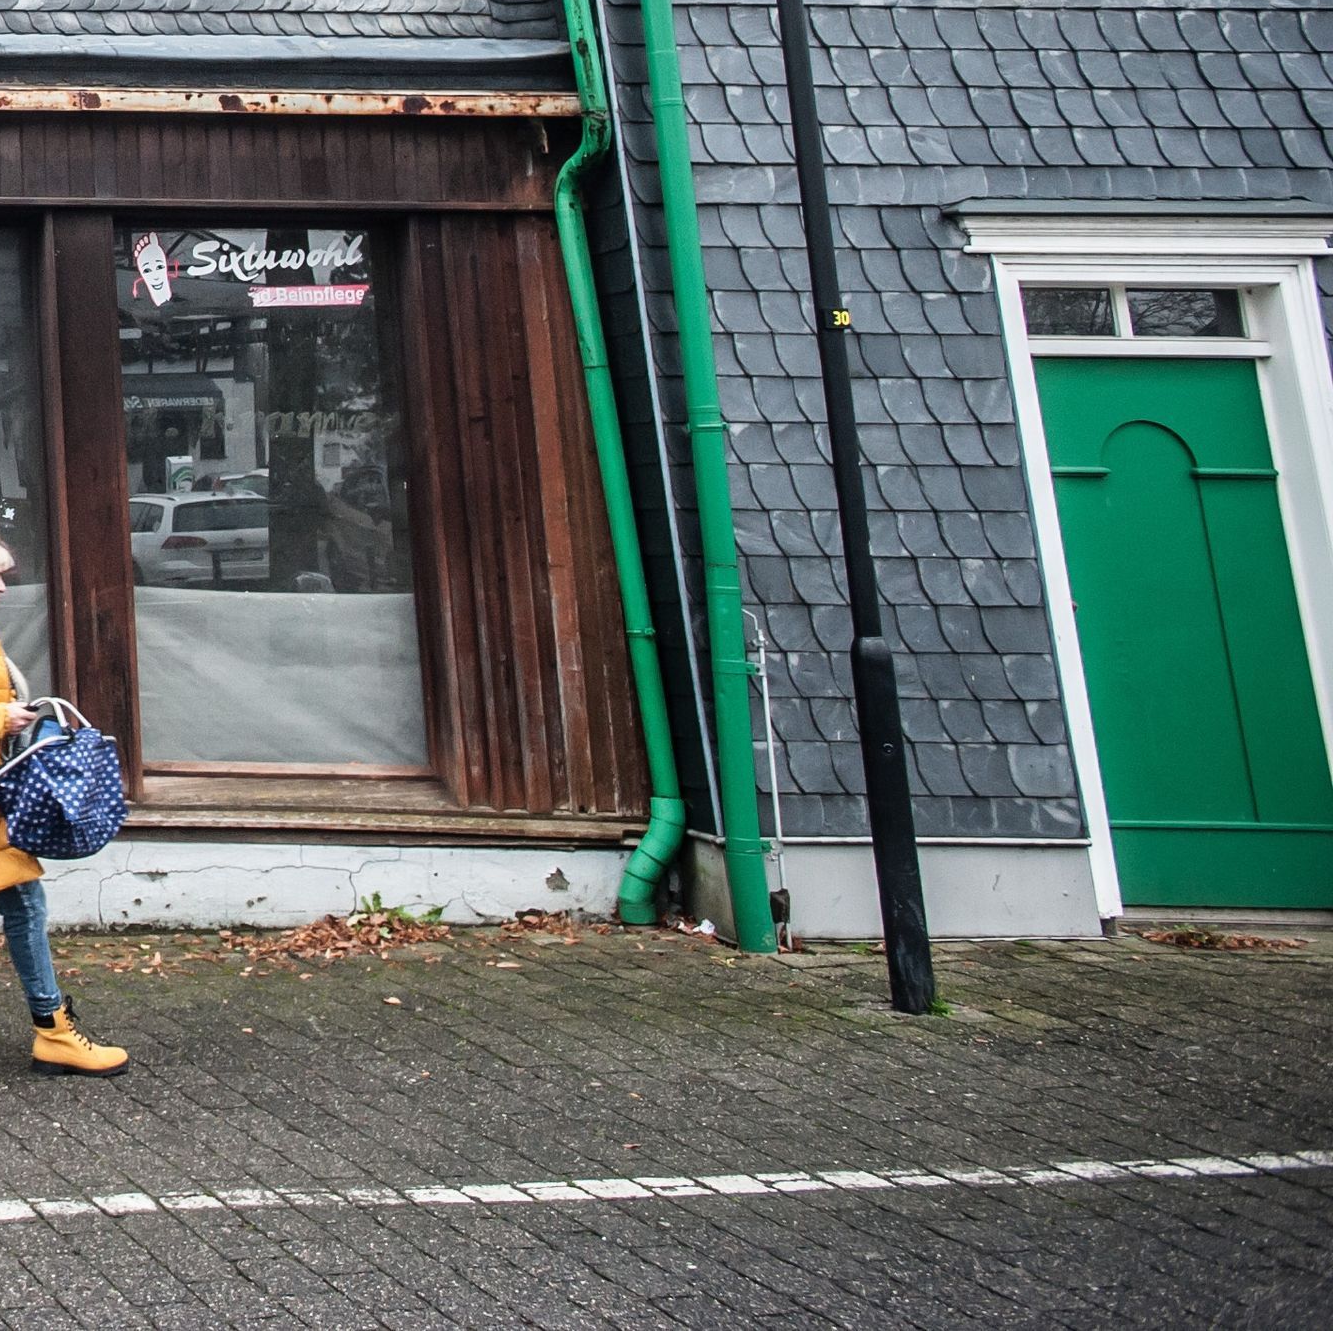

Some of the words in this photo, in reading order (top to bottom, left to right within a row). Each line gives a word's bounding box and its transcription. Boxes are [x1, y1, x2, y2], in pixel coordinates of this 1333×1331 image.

[187, 235, 364, 281] Sixtuwohl
[276, 286, 364, 304] Beinpflege
[832, 310, 850, 326] 30
